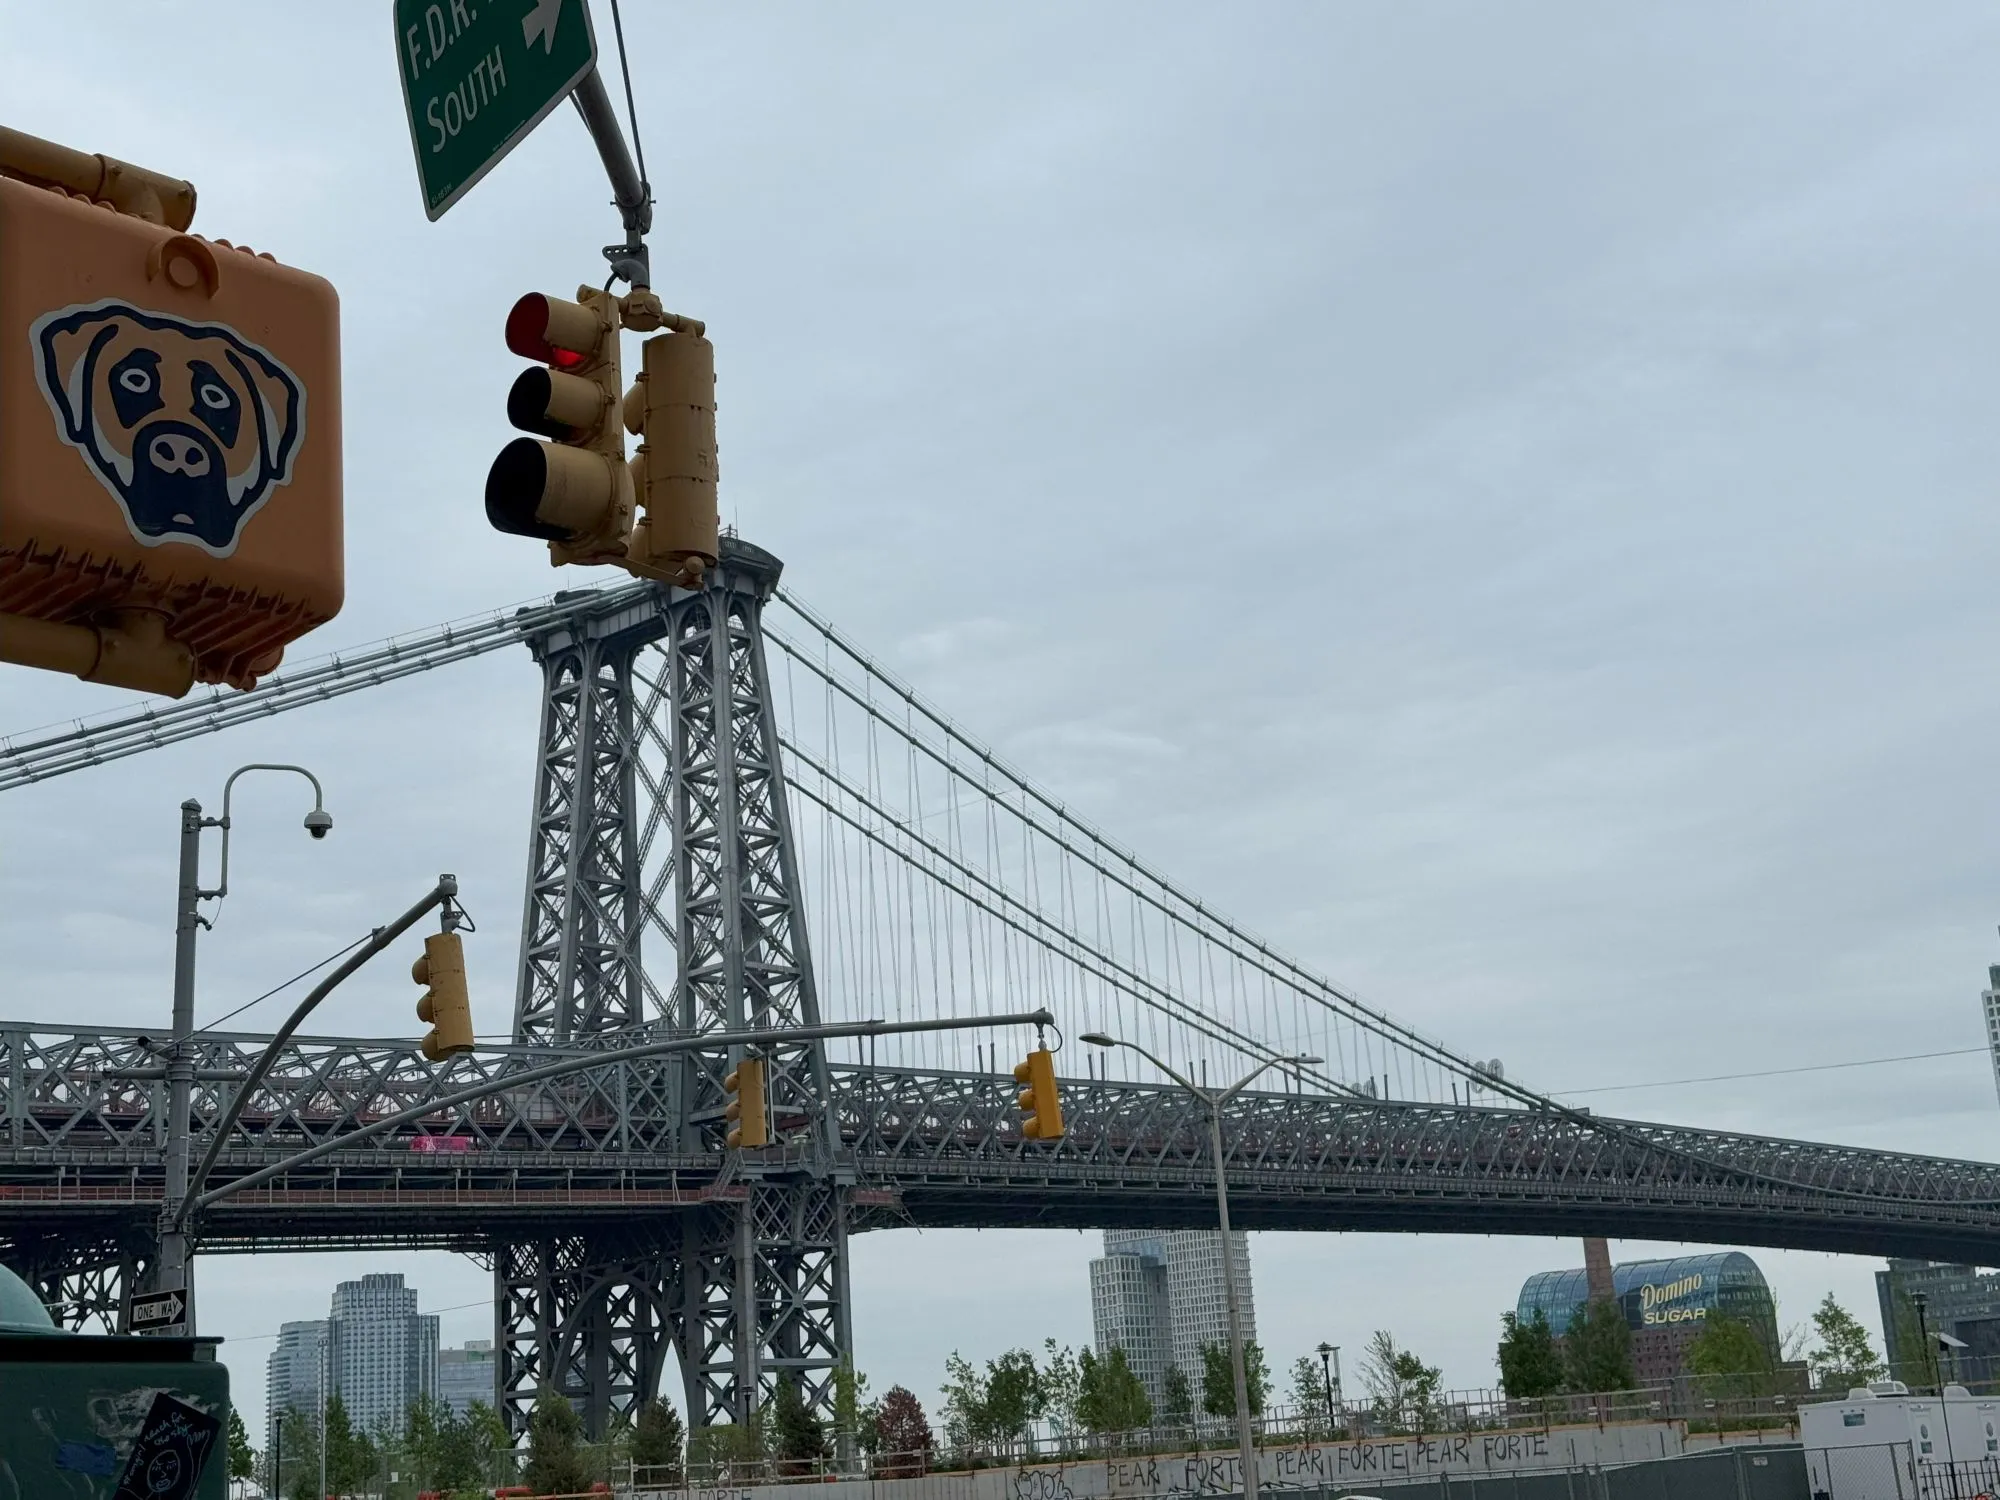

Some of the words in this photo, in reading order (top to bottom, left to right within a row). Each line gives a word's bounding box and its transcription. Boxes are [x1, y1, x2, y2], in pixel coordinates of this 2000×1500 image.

[406, 0, 477, 81] F.D.R.
[426, 44, 507, 153] SOUTH
[137, 1308, 154, 1319] ONE
[160, 1301, 179, 1316] WAY
[1640, 1273, 1702, 1311] Domino
[1643, 1308, 1707, 1325] SUGAR
[1107, 1461, 1161, 1488] PEAR
[1184, 1456, 1244, 1490] FORT
[1276, 1448, 1324, 1477] PEAR
[1338, 1444, 1406, 1474] FORTE
[1417, 1437, 1469, 1465] PEAR
[1484, 1433, 1549, 1467] FORTE
